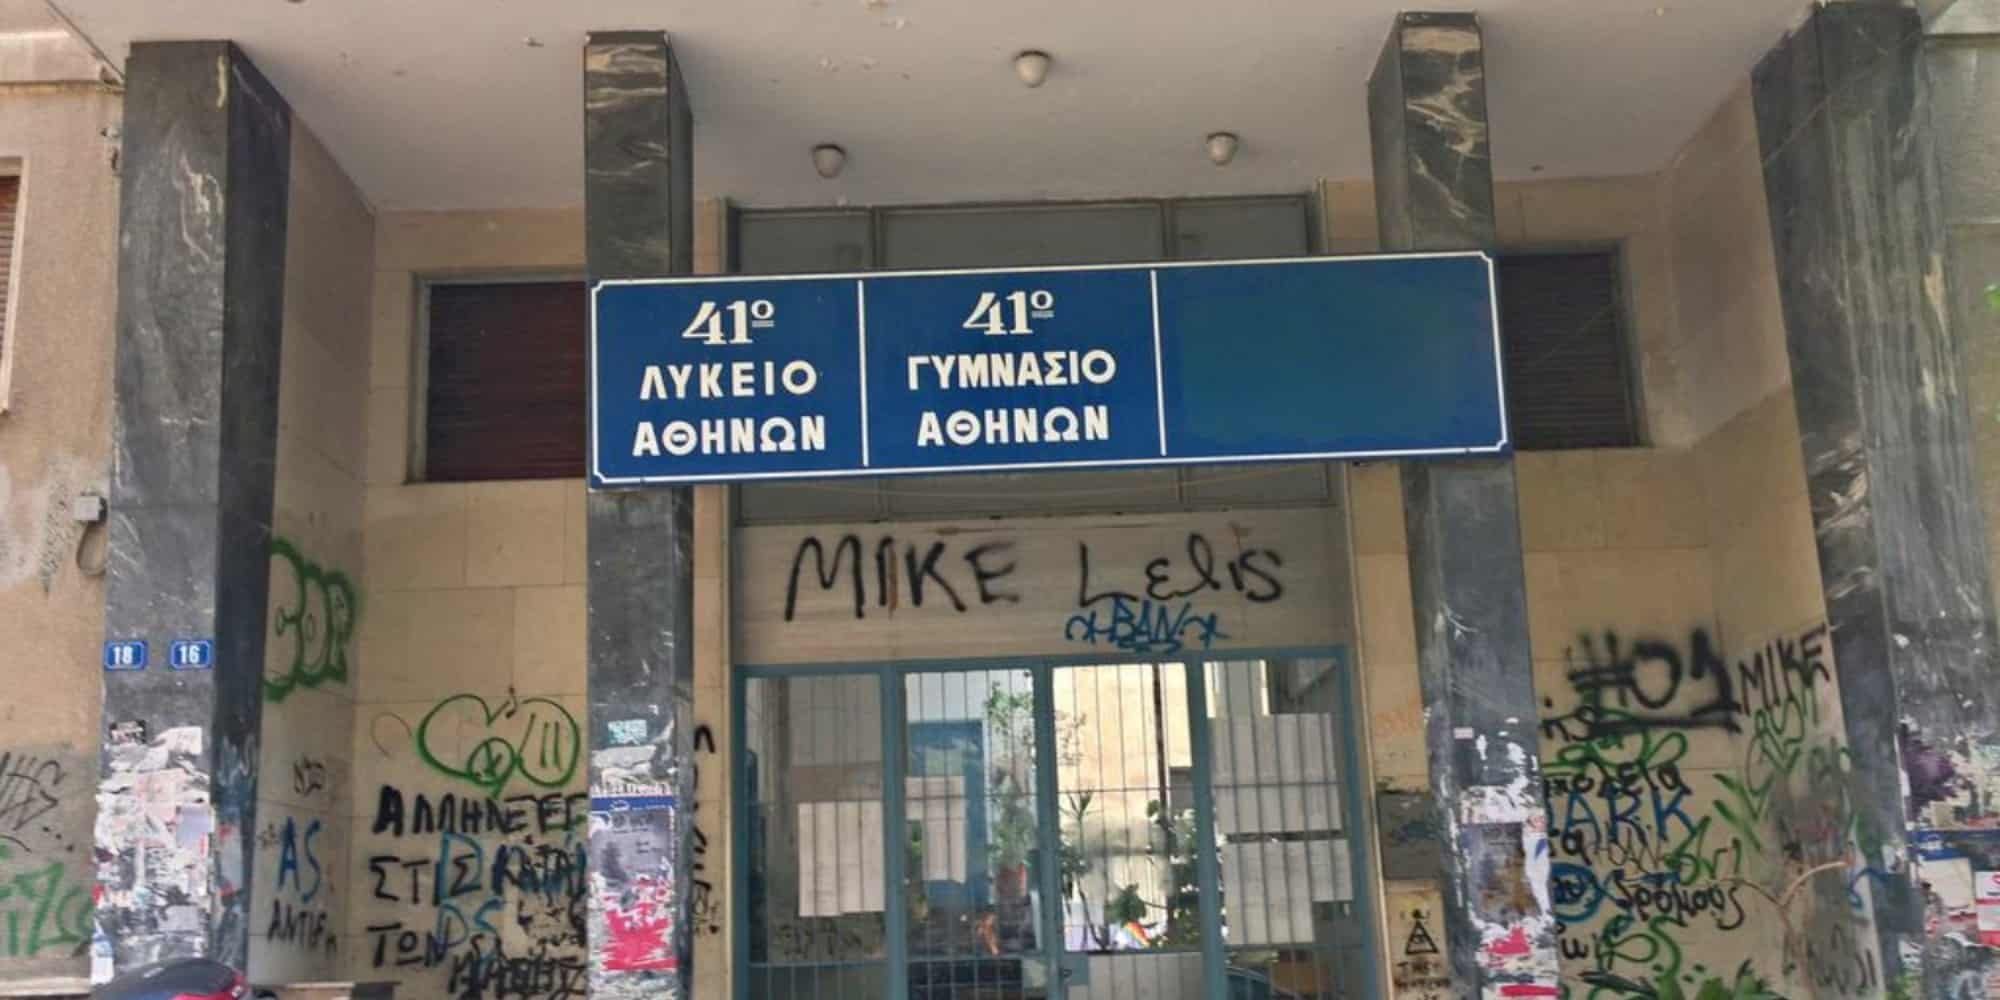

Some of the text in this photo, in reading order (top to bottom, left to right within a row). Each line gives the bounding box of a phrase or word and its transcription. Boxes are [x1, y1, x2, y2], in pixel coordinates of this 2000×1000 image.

[639, 360, 817, 400] ΛΥΚΕΙΟ
[908, 349, 1116, 390] ΓΥΜΝΑΣΙΟ
[632, 415, 825, 457] ΑΘΗΝΩΝ
[917, 405, 1109, 447] ΑΘΗΝΩΝ
[784, 533, 1019, 622] MIKE
[113, 645, 133, 666] 18
[179, 644, 200, 665] 16
[1738, 622, 1830, 716] MIKE
[1544, 782, 1698, 849] ARK
